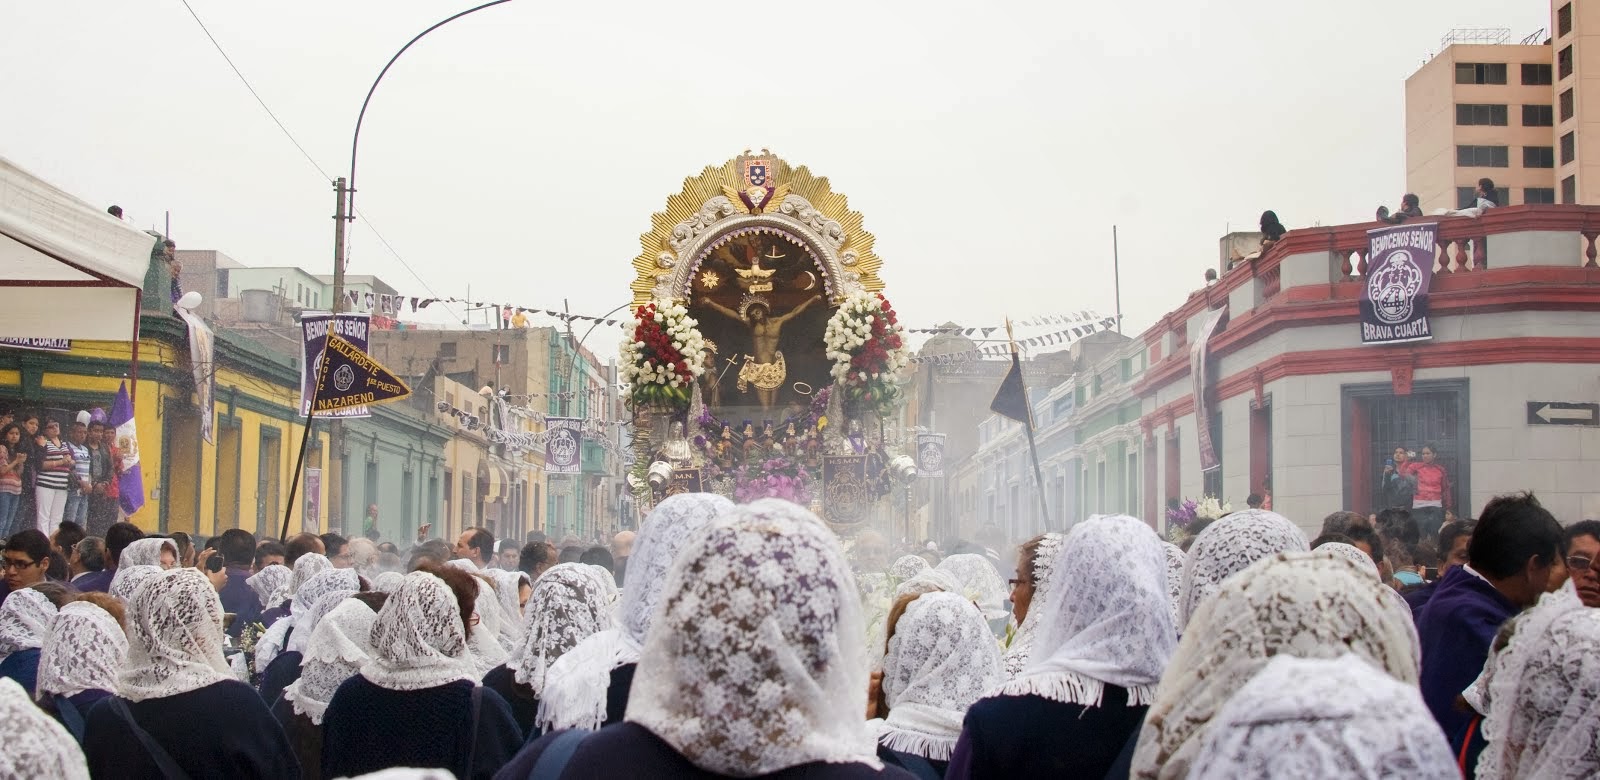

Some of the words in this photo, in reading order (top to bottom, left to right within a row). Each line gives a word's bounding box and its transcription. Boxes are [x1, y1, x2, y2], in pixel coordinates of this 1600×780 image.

[1371, 231, 1409, 259] BENDICENOS
[1410, 227, 1433, 252] SEÑOR
[306, 320, 343, 341] BENDICOS
[344, 318, 366, 341] SEÑOR
[1363, 322, 1393, 340] BRAVA
[1395, 316, 1428, 337] CUARTA
[329, 338, 380, 376] GALLARDETE
[376, 381, 400, 394] PUESTO
[318, 392, 374, 410] NAZARENO
